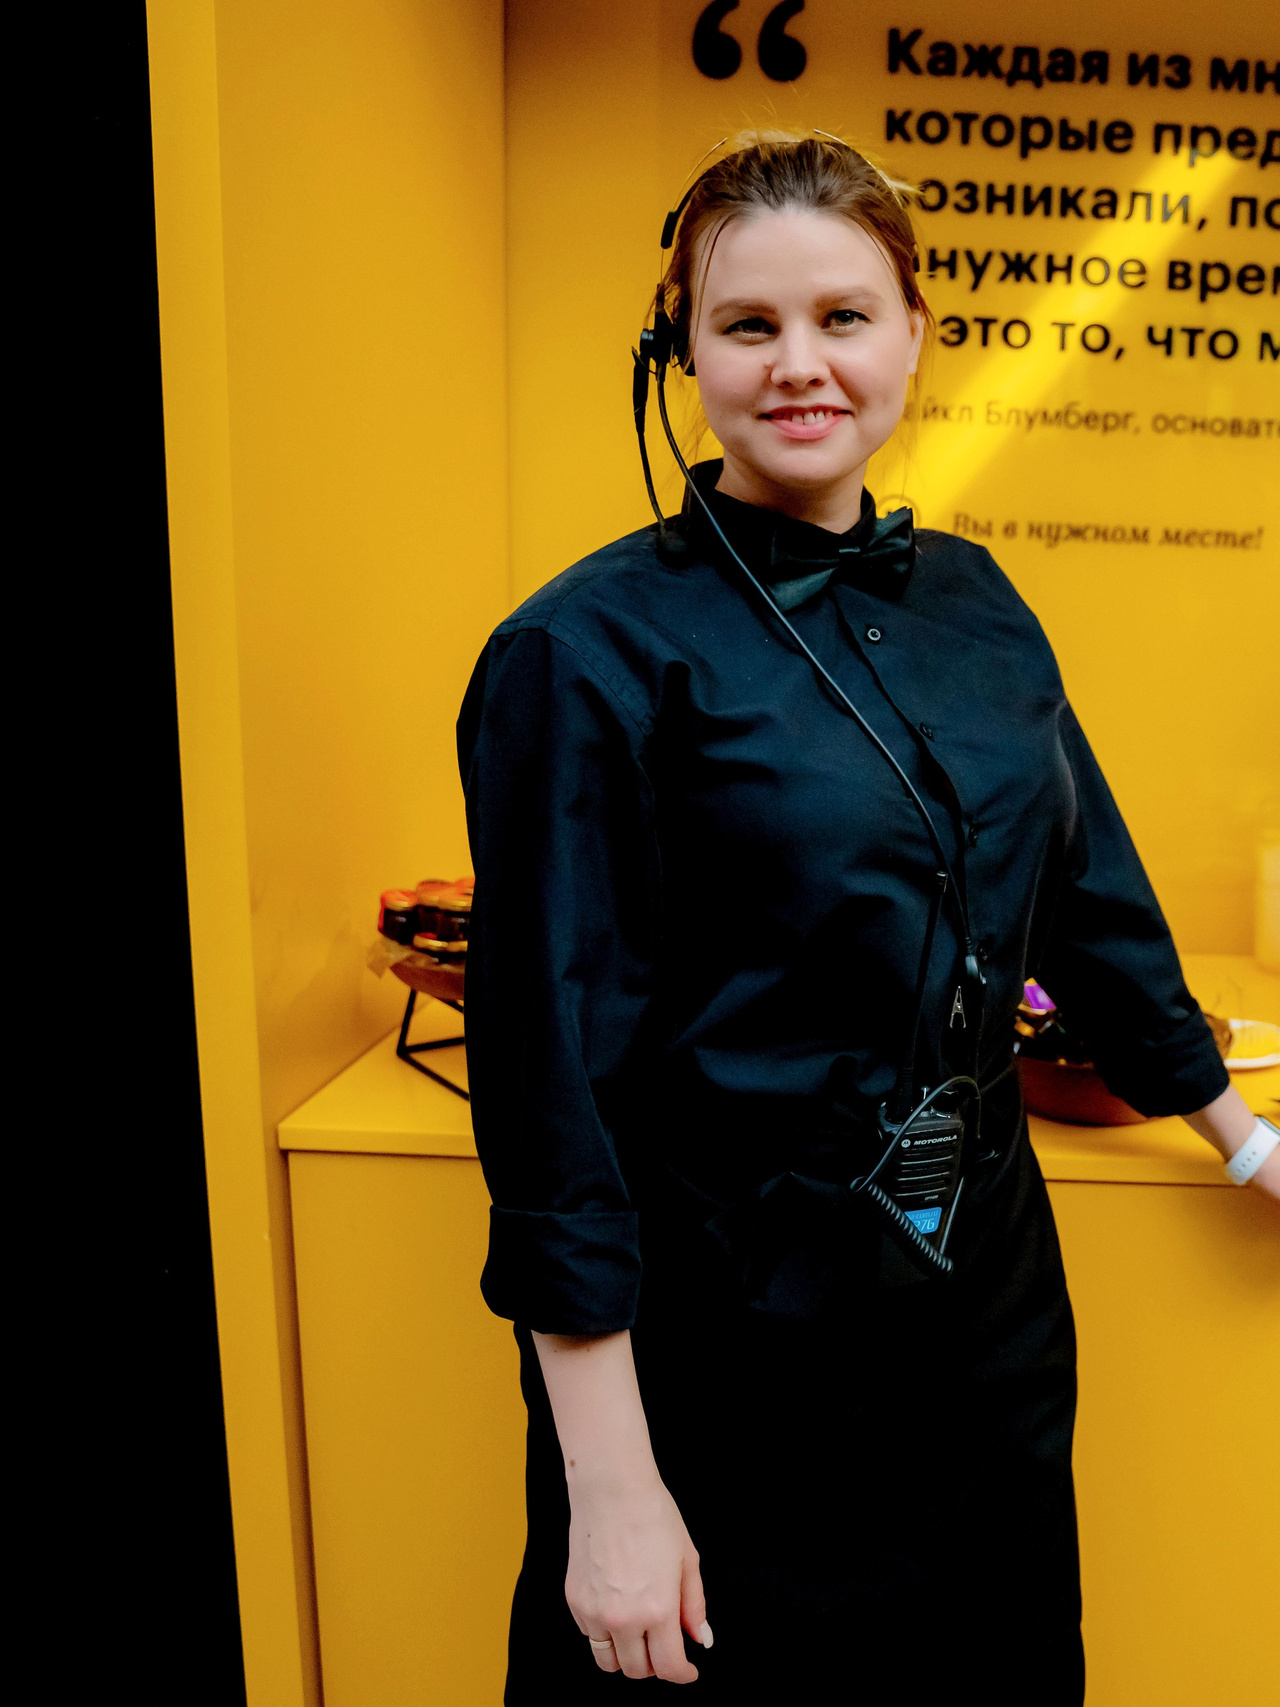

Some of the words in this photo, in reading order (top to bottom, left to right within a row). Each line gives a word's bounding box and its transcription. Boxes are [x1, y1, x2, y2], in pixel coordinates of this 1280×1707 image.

[887, 27, 1109, 89] Каждая
[1127, 53, 1191, 90] из
[886, 109, 1134, 160] которые
[925, 246, 1147, 293] нужное
[939, 315, 1030, 348] это
[1052, 323, 1126, 362] то,
[1147, 326, 1239, 360] что
[952, 516, 992, 540] Вы
[1002, 520, 1018, 541] в
[1028, 523, 1149, 548] нужном
[1159, 528, 1263, 549] месте!
[913, 1134, 957, 1146] MOTOROLA
